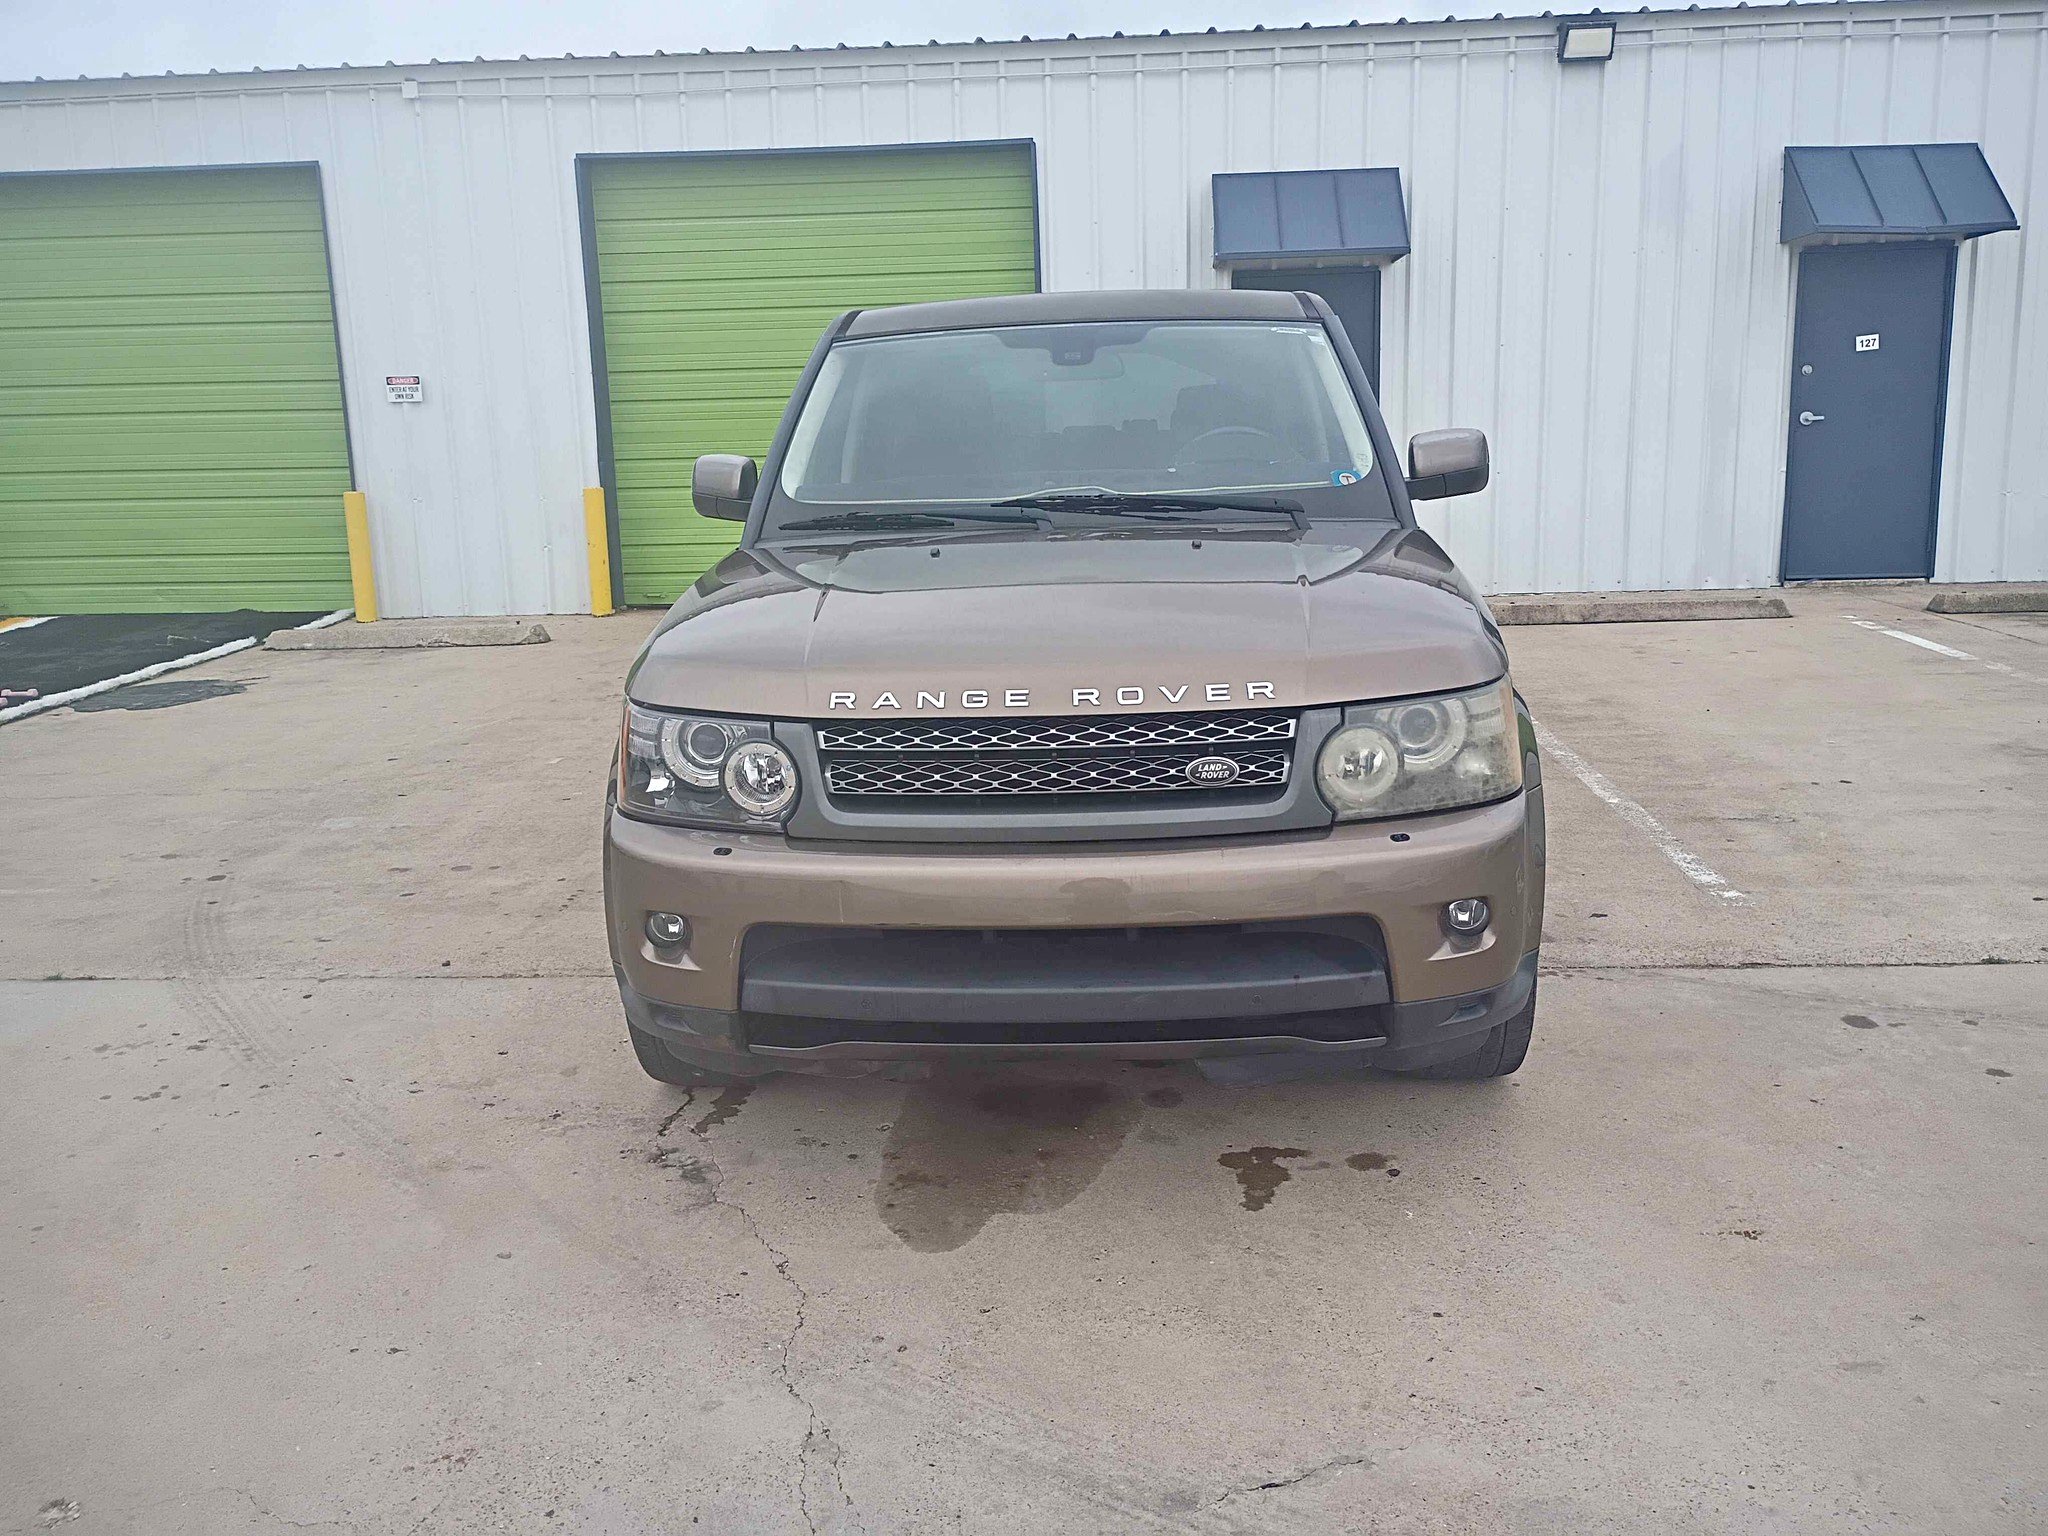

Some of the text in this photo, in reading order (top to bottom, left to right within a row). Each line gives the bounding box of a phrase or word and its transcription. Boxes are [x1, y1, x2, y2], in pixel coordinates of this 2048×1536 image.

[1860, 338, 1876, 348] 127
[829, 680, 1277, 710] RANGE ROVER
